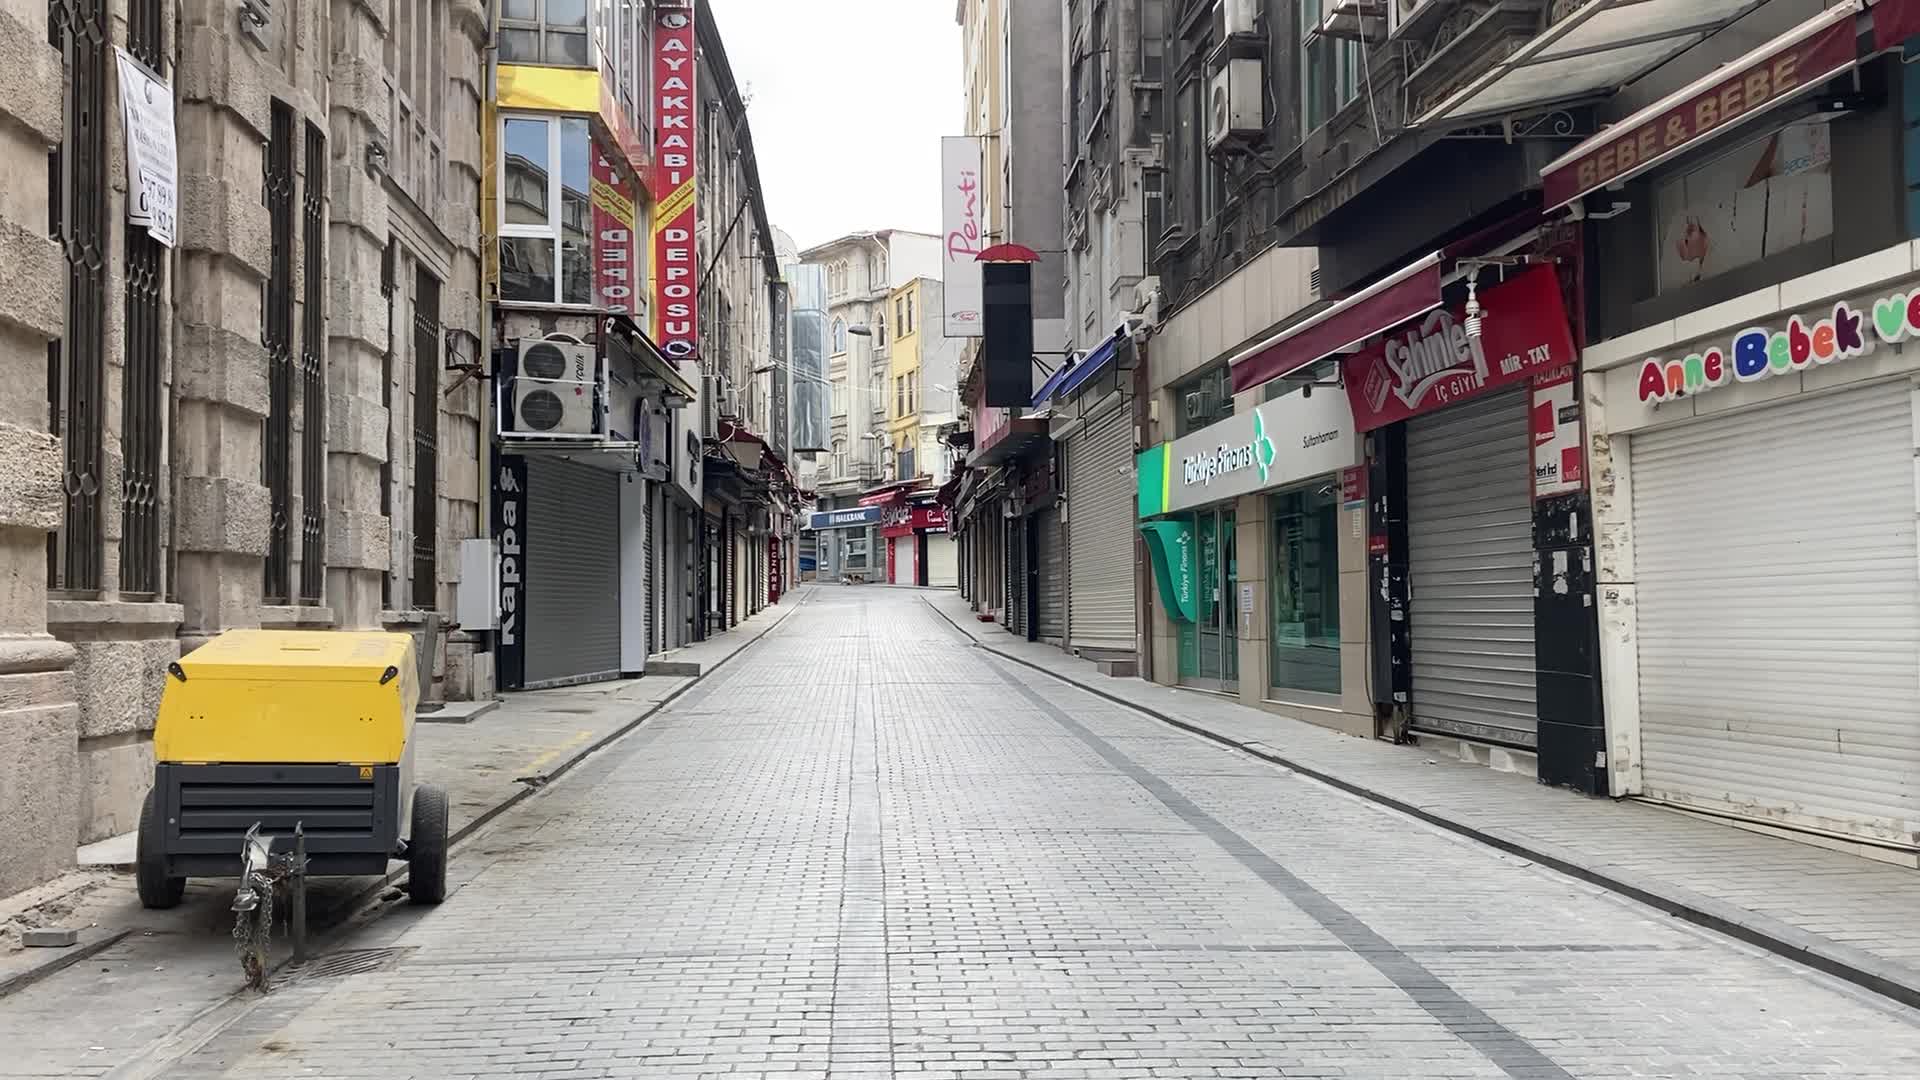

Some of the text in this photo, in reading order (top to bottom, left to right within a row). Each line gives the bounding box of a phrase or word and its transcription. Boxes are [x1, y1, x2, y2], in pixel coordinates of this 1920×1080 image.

[661, 37, 689, 185] AYAKKABI
[1577, 54, 1798, 191] BEBE & BEBE
[949, 169, 981, 263] Penti
[664, 229, 691, 335] DEPOSU
[1528, 343, 1550, 365] TAY
[1638, 348, 1723, 402] Anne
[1734, 305, 1862, 378] Bebek
[1183, 443, 1252, 487] Türkiye Finans
[502, 501, 521, 645] Kappa
[769, 543, 778, 592] ECZANE
